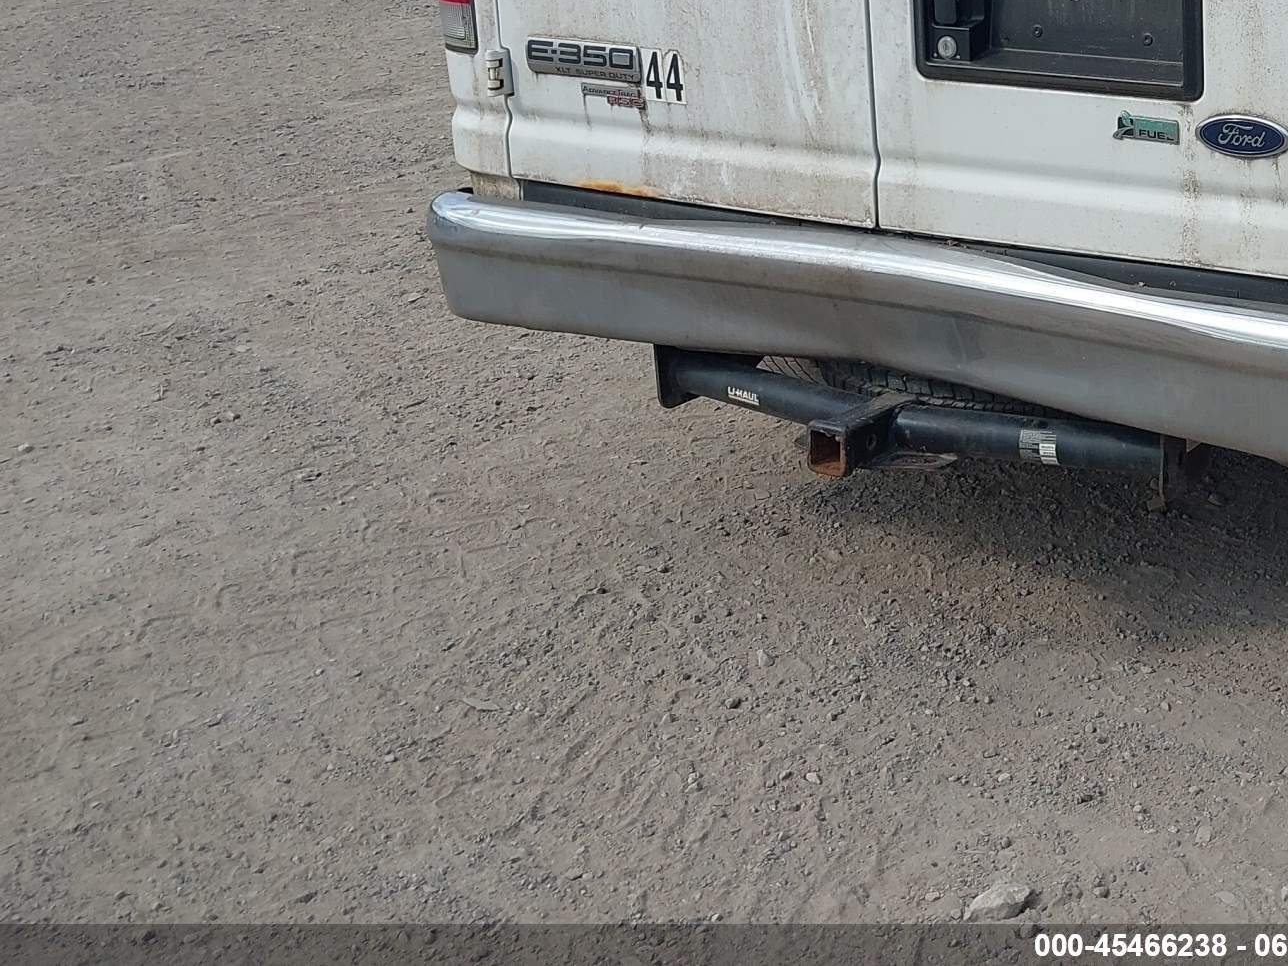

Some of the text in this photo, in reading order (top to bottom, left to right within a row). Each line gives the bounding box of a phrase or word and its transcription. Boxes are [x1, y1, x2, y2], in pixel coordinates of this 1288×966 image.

[527, 39, 634, 70] E-350
[576, 68, 606, 77] SUPER
[609, 72, 634, 80] DUTY
[646, 51, 683, 102] 44
[1218, 123, 1265, 148] Ford
[727, 386, 759, 403] U-HAUL
